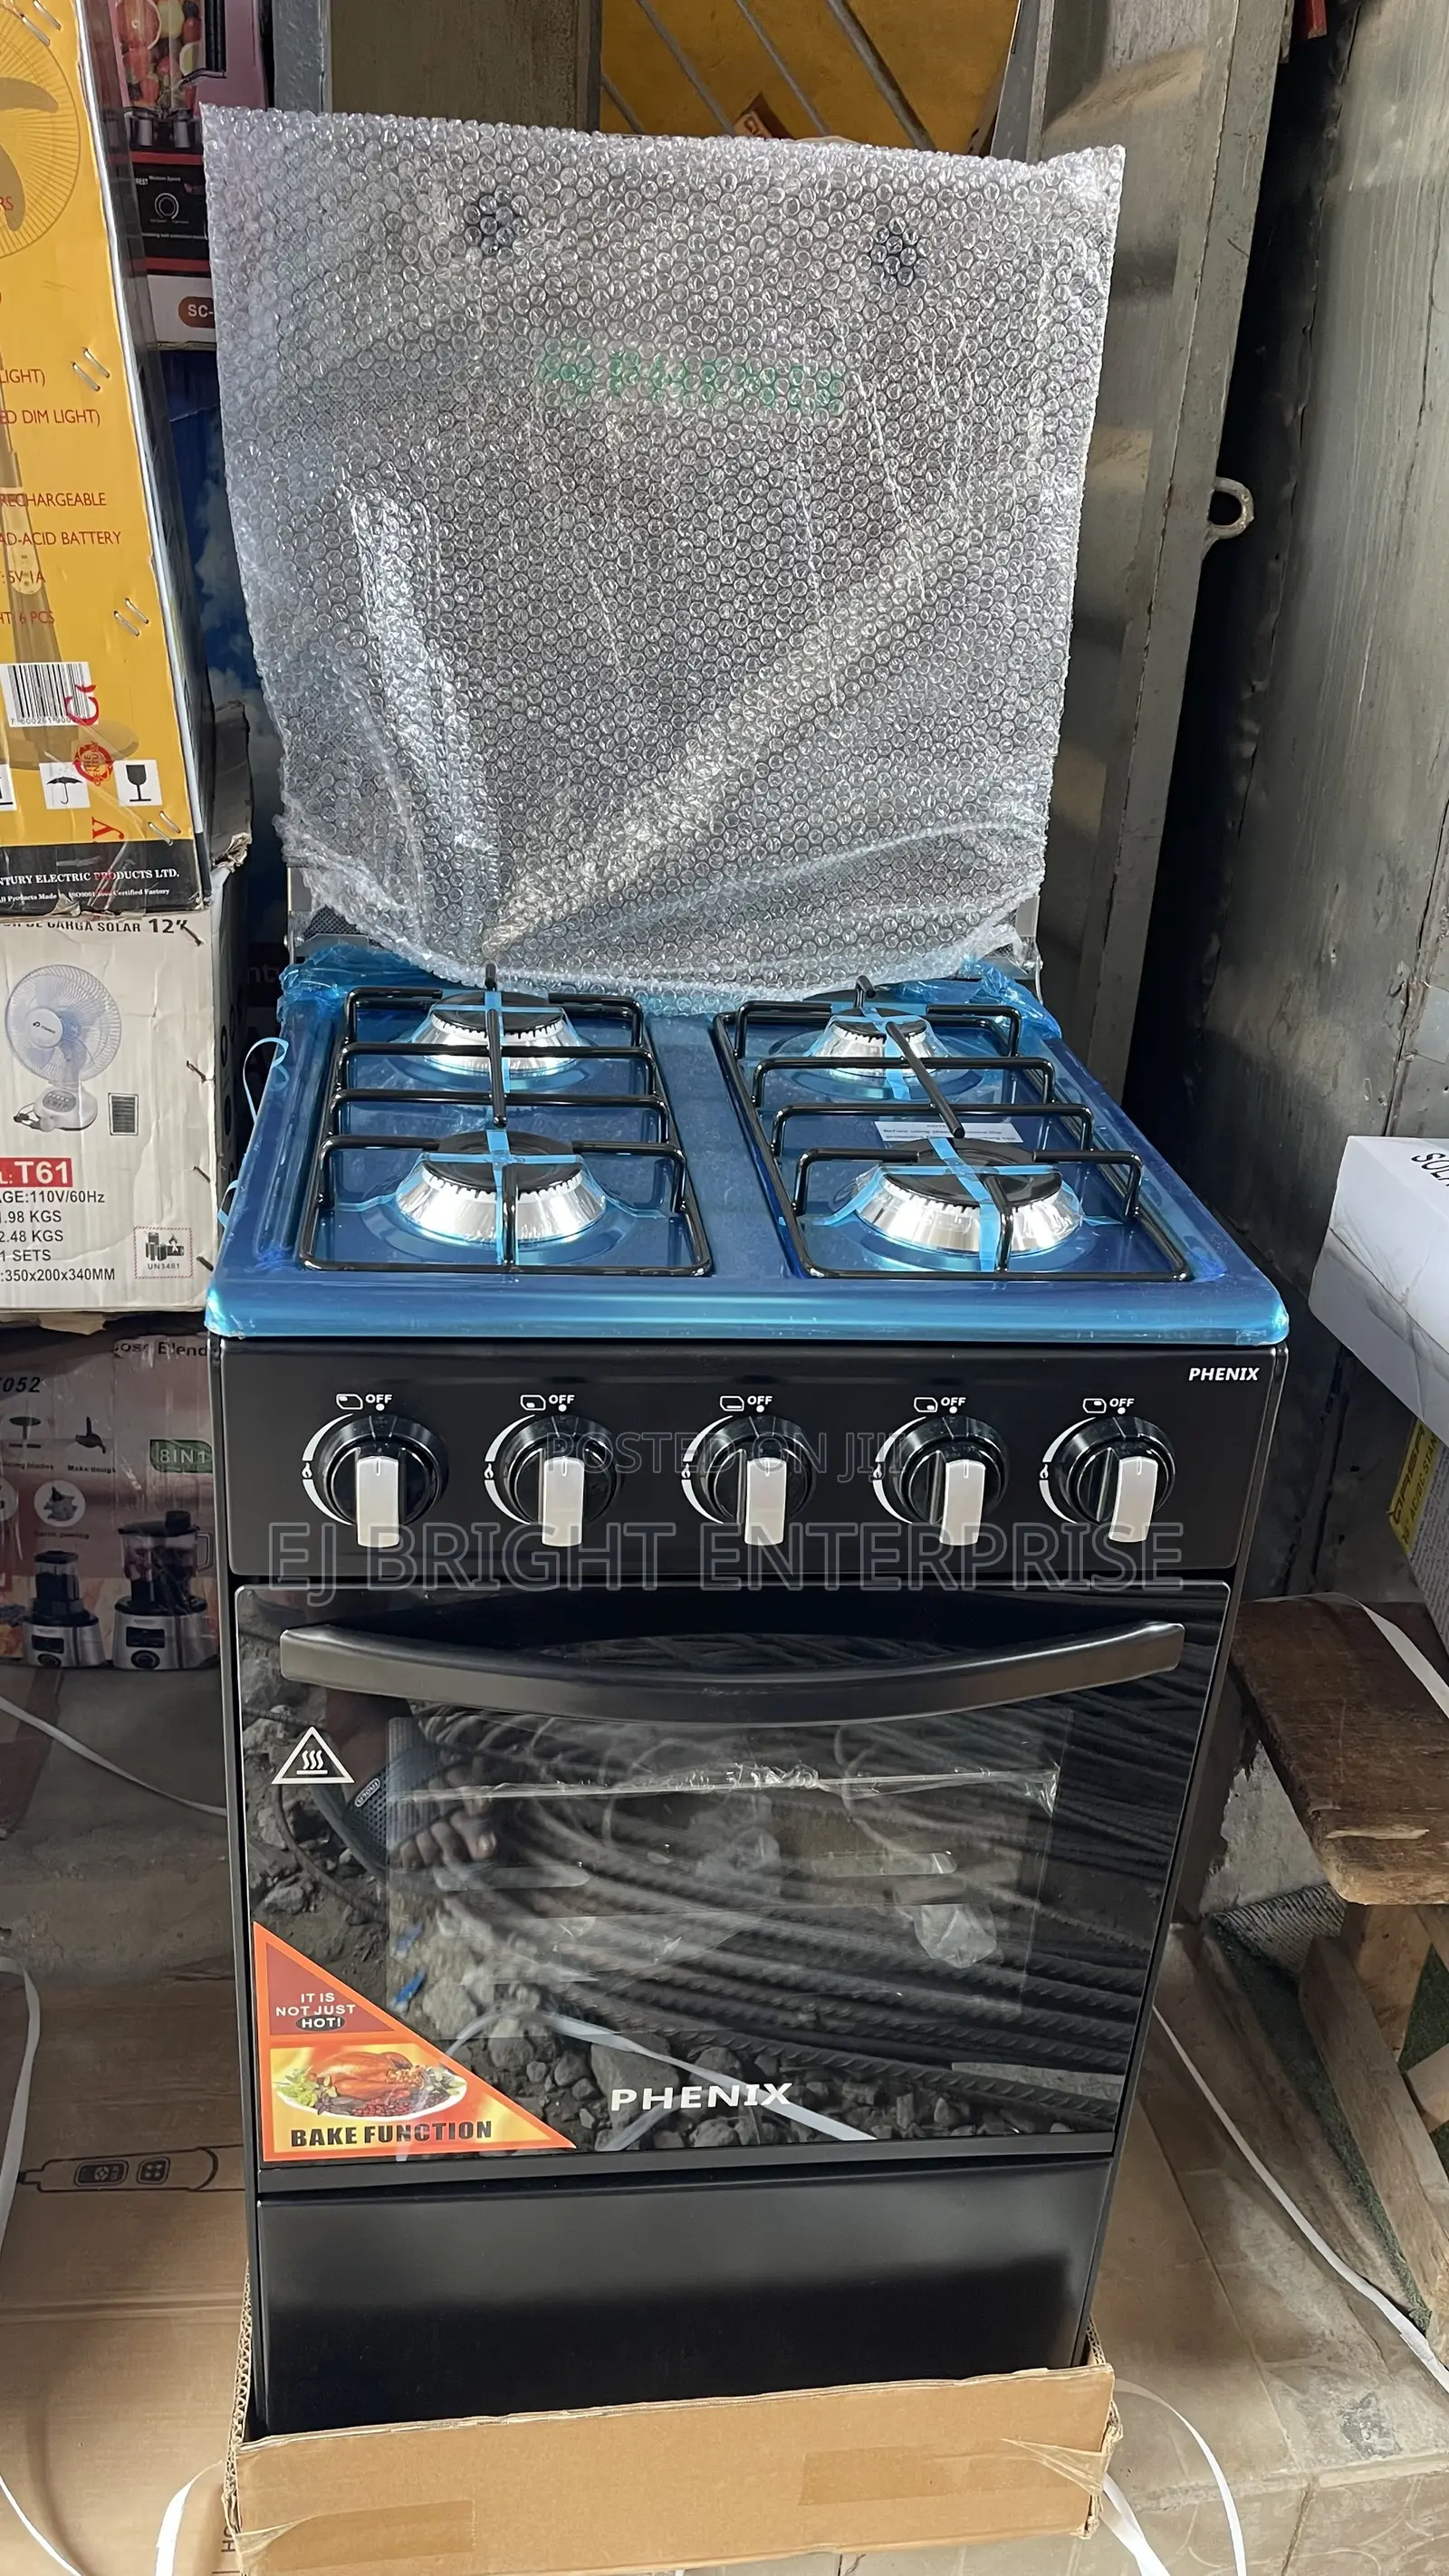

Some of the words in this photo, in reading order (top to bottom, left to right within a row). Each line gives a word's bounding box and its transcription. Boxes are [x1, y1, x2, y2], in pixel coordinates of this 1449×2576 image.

[23, 409, 50, 425] DIM
[54, 409, 101, 427] LIGHT)
[1, 492, 108, 508] RECHARGEABLE
[61, 531, 121, 545] BATTERY
[35, 873, 91, 884] ELECTRIC
[93, 869, 153, 881] PRODUCTS
[155, 868, 180, 878] LTD.
[38, 892, 57, 901] Made
[144, 887, 170, 897] Factory
[97, 923, 141, 933] SOLAR
[14, 1160, 69, 1184] T61
[30, 1210, 62, 1223] KGS
[32, 1230, 64, 1242] KGS
[13, 1250, 52, 1261] SETS
[1187, 1367, 1261, 1383] PHENIX
[0, 1376, 41, 1393] 052
[365, 1393, 393, 1405] OFF
[548, 1394, 576, 1405] OFF
[746, 1394, 773, 1406] OFF
[940, 1396, 966, 1408] OFF
[1108, 1398, 1135, 1409] OFF
[300, 1993, 315, 2003] IT
[319, 1992, 335, 2003] IS
[275, 2006, 312, 2016] NOT
[313, 2004, 357, 2016] JUST
[301, 2016, 342, 2029] HOT!
[610, 2083, 793, 2112] PHENIX
[290, 2126, 359, 2147] BAKE
[364, 2120, 493, 2143] FUNCTION
